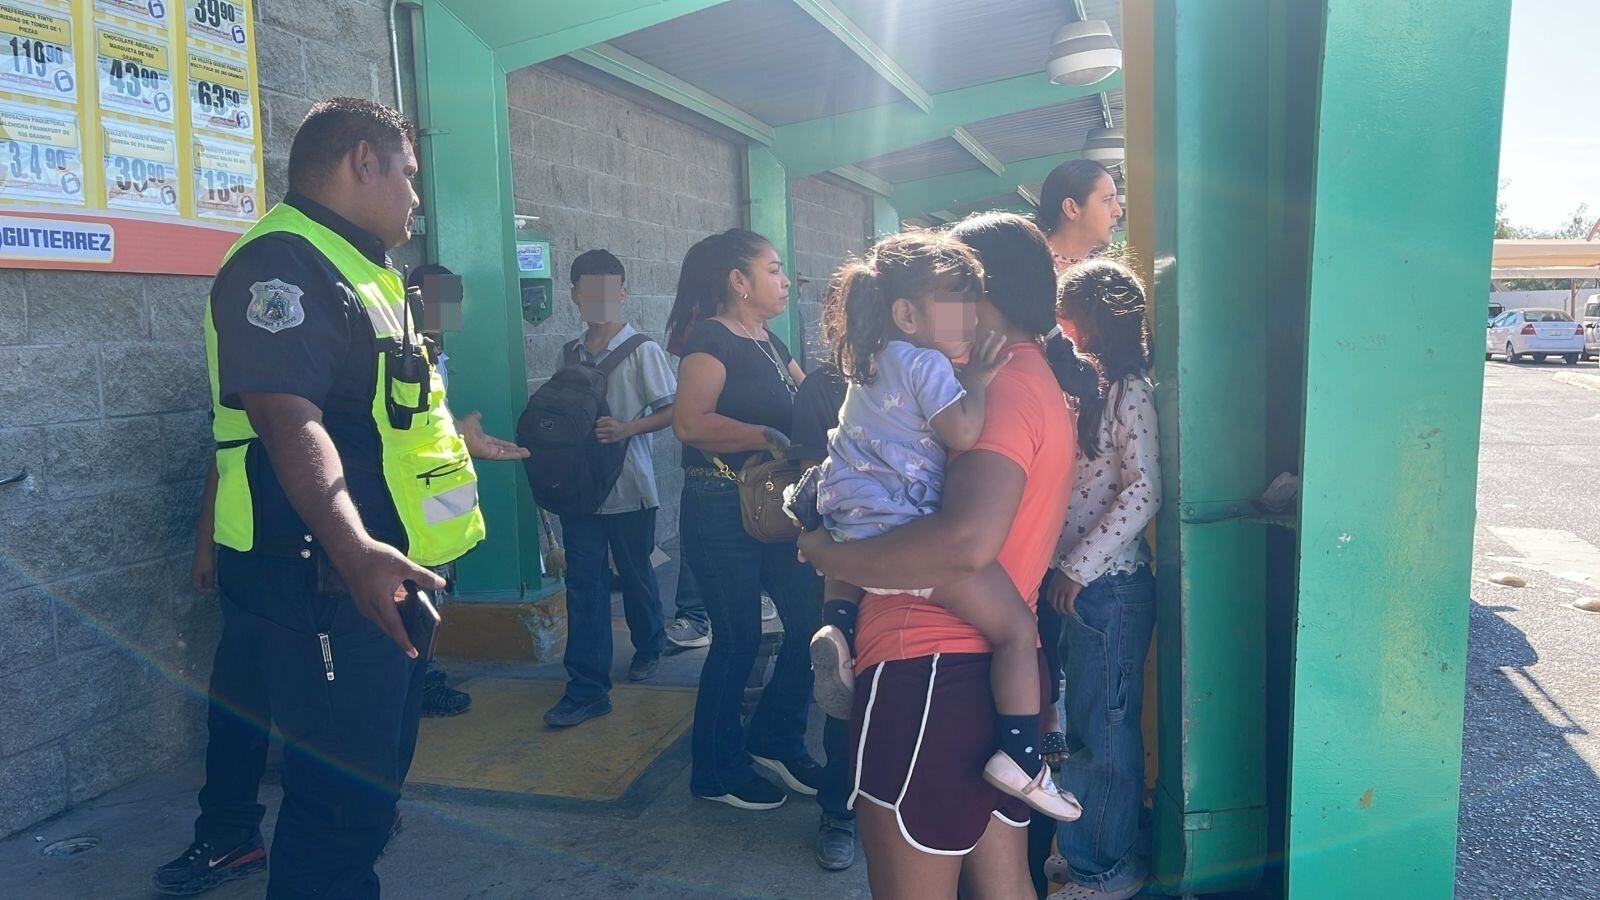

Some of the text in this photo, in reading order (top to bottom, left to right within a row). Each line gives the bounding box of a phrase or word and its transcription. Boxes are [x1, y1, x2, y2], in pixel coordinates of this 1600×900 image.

[103, 33, 159, 51] CHOCOLATE ABUELITA
[109, 43, 137, 54] MARQUETA
[3, 227, 111, 252] GUTIERREZ
